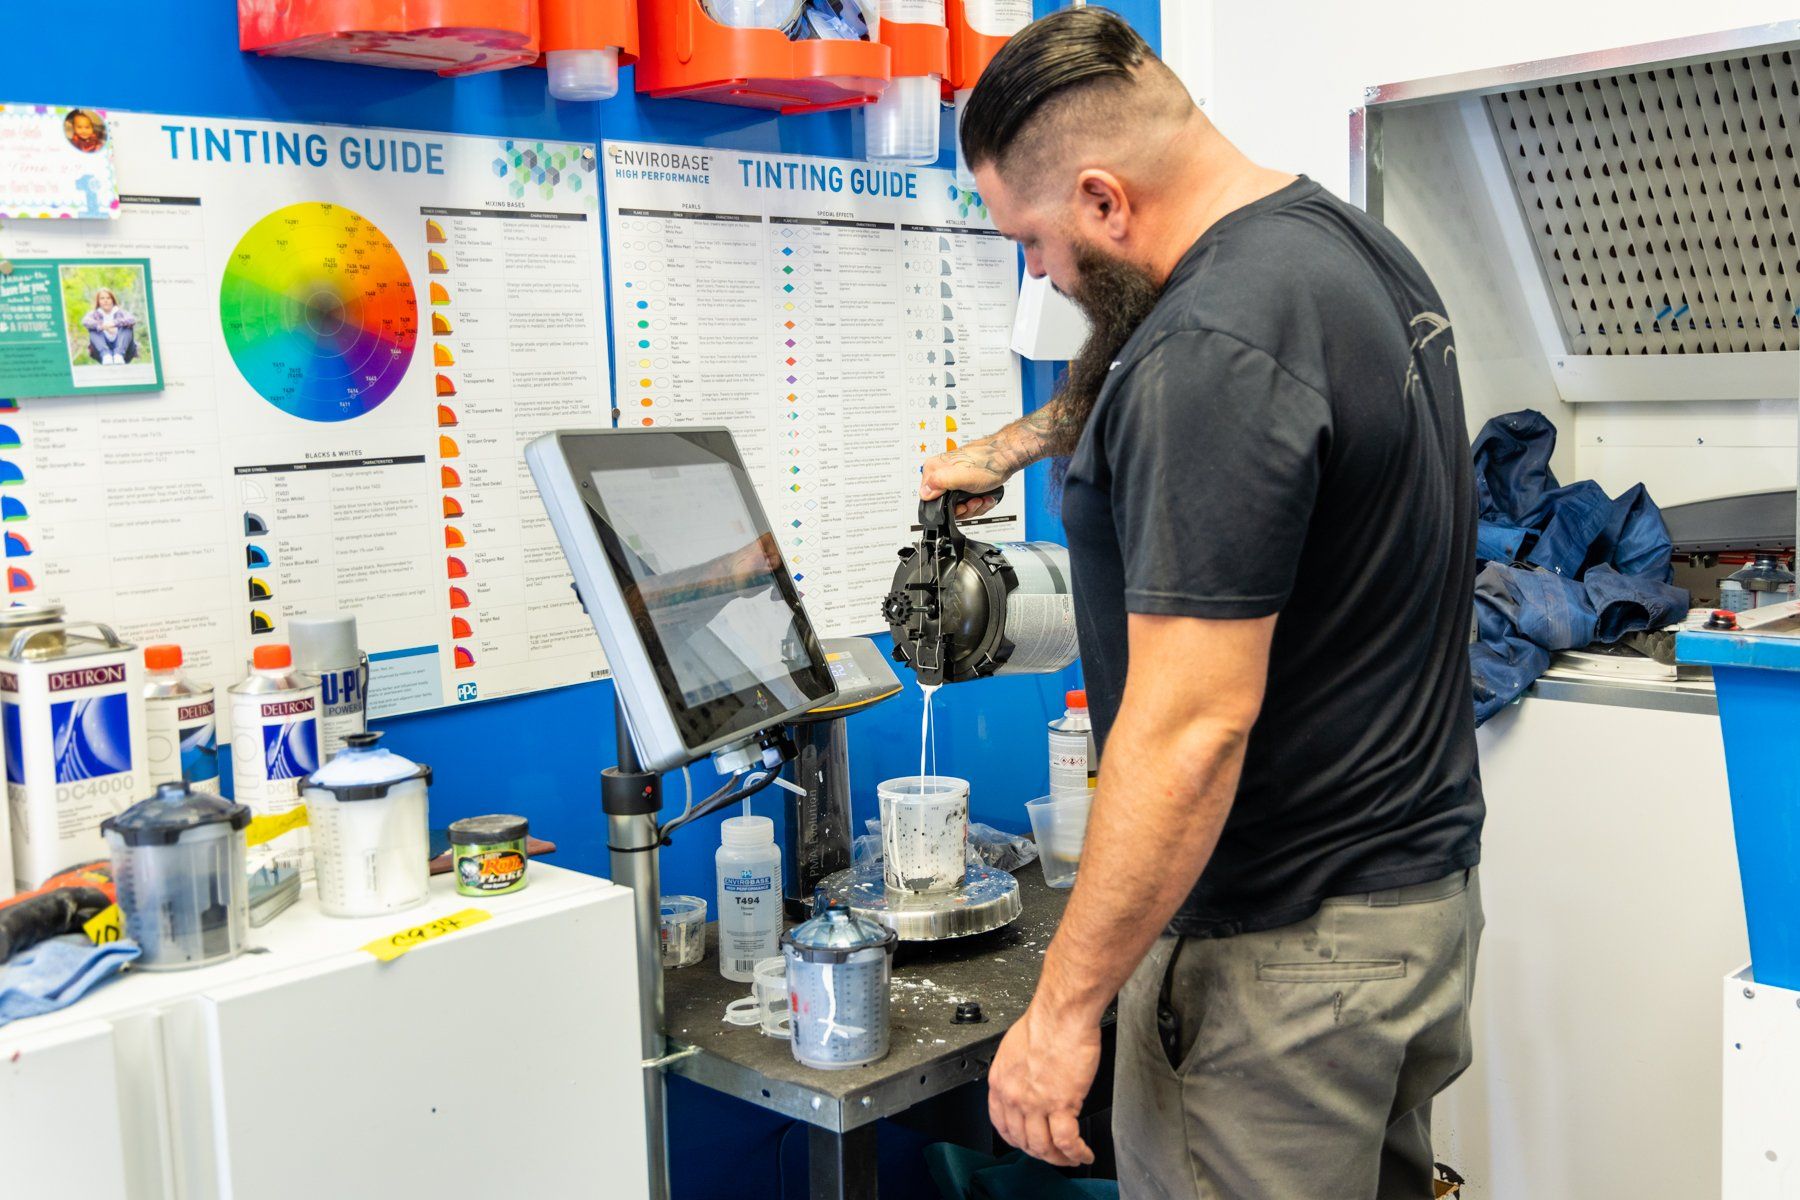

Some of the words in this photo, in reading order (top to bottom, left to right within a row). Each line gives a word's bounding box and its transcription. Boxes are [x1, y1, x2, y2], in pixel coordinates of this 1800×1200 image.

[162, 125, 328, 168] TINTING
[340, 134, 444, 176] GUIDE
[616, 169, 638, 178] HIGH
[642, 172, 710, 184] PERFORMANCE
[738, 160, 842, 192] TINTING
[850, 168, 916, 198] GUIDE
[52, 666, 122, 690] DELTRON
[459, 684, 477, 699] PPG
[180, 702, 214, 720] DELTRO
[263, 700, 315, 716] DELTRON
[56, 776, 134, 802] DC4000
[808, 789, 818, 844] Evolution
[810, 849, 819, 877] PMA
[735, 896, 760, 905] T494
